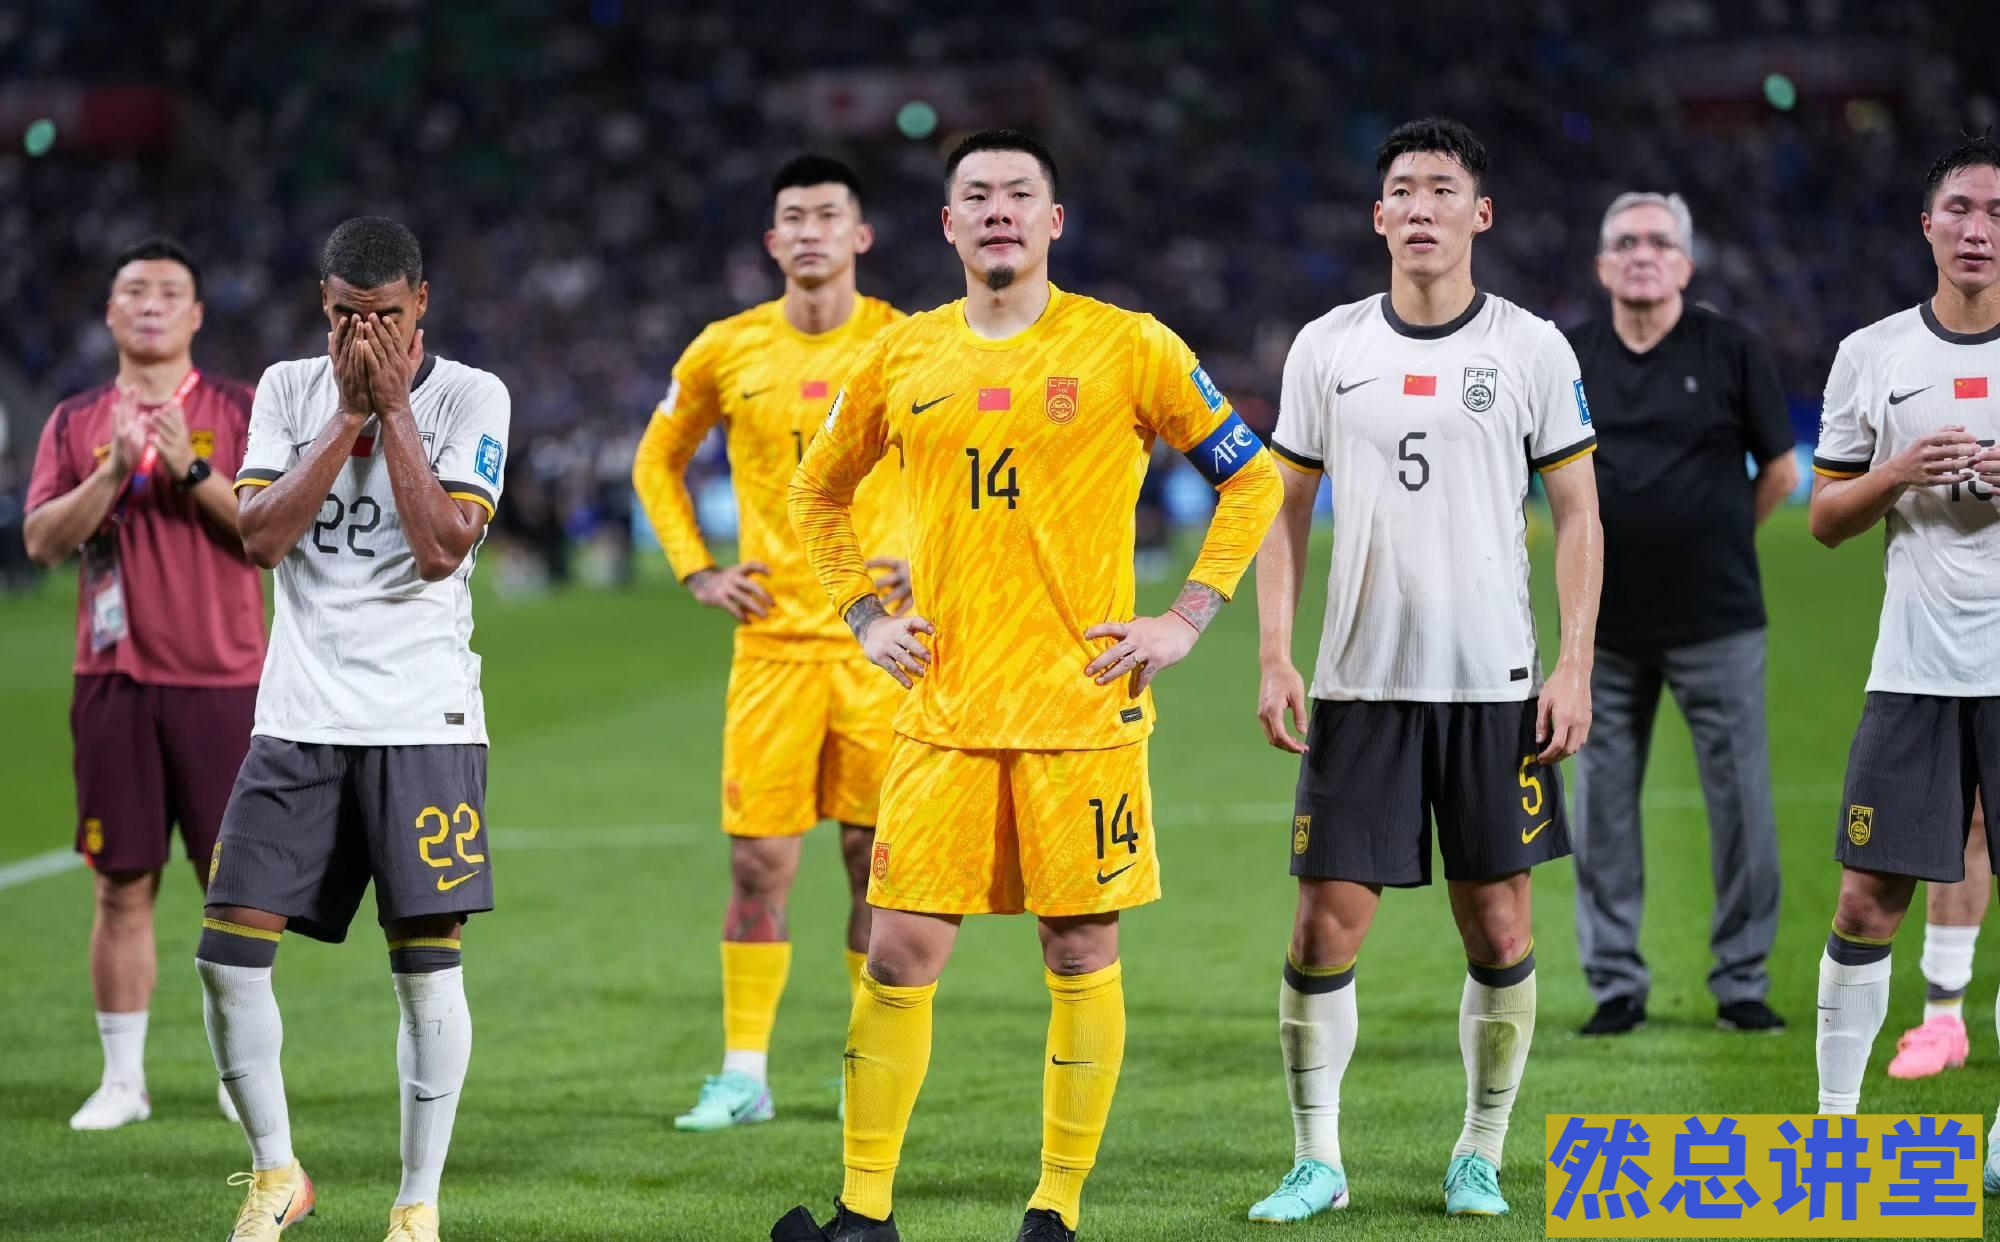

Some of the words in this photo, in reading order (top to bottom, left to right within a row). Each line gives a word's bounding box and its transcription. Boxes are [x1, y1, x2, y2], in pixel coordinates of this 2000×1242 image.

[1468, 370, 1494, 378] CFA
[966, 448, 1019, 510] 14
[1212, 424, 1253, 474] AFC
[1399, 432, 1429, 491] 5
[313, 493, 381, 557] 22
[1519, 754, 1543, 816] 5
[415, 802, 485, 867] 22
[1089, 793, 1139, 859] 14
